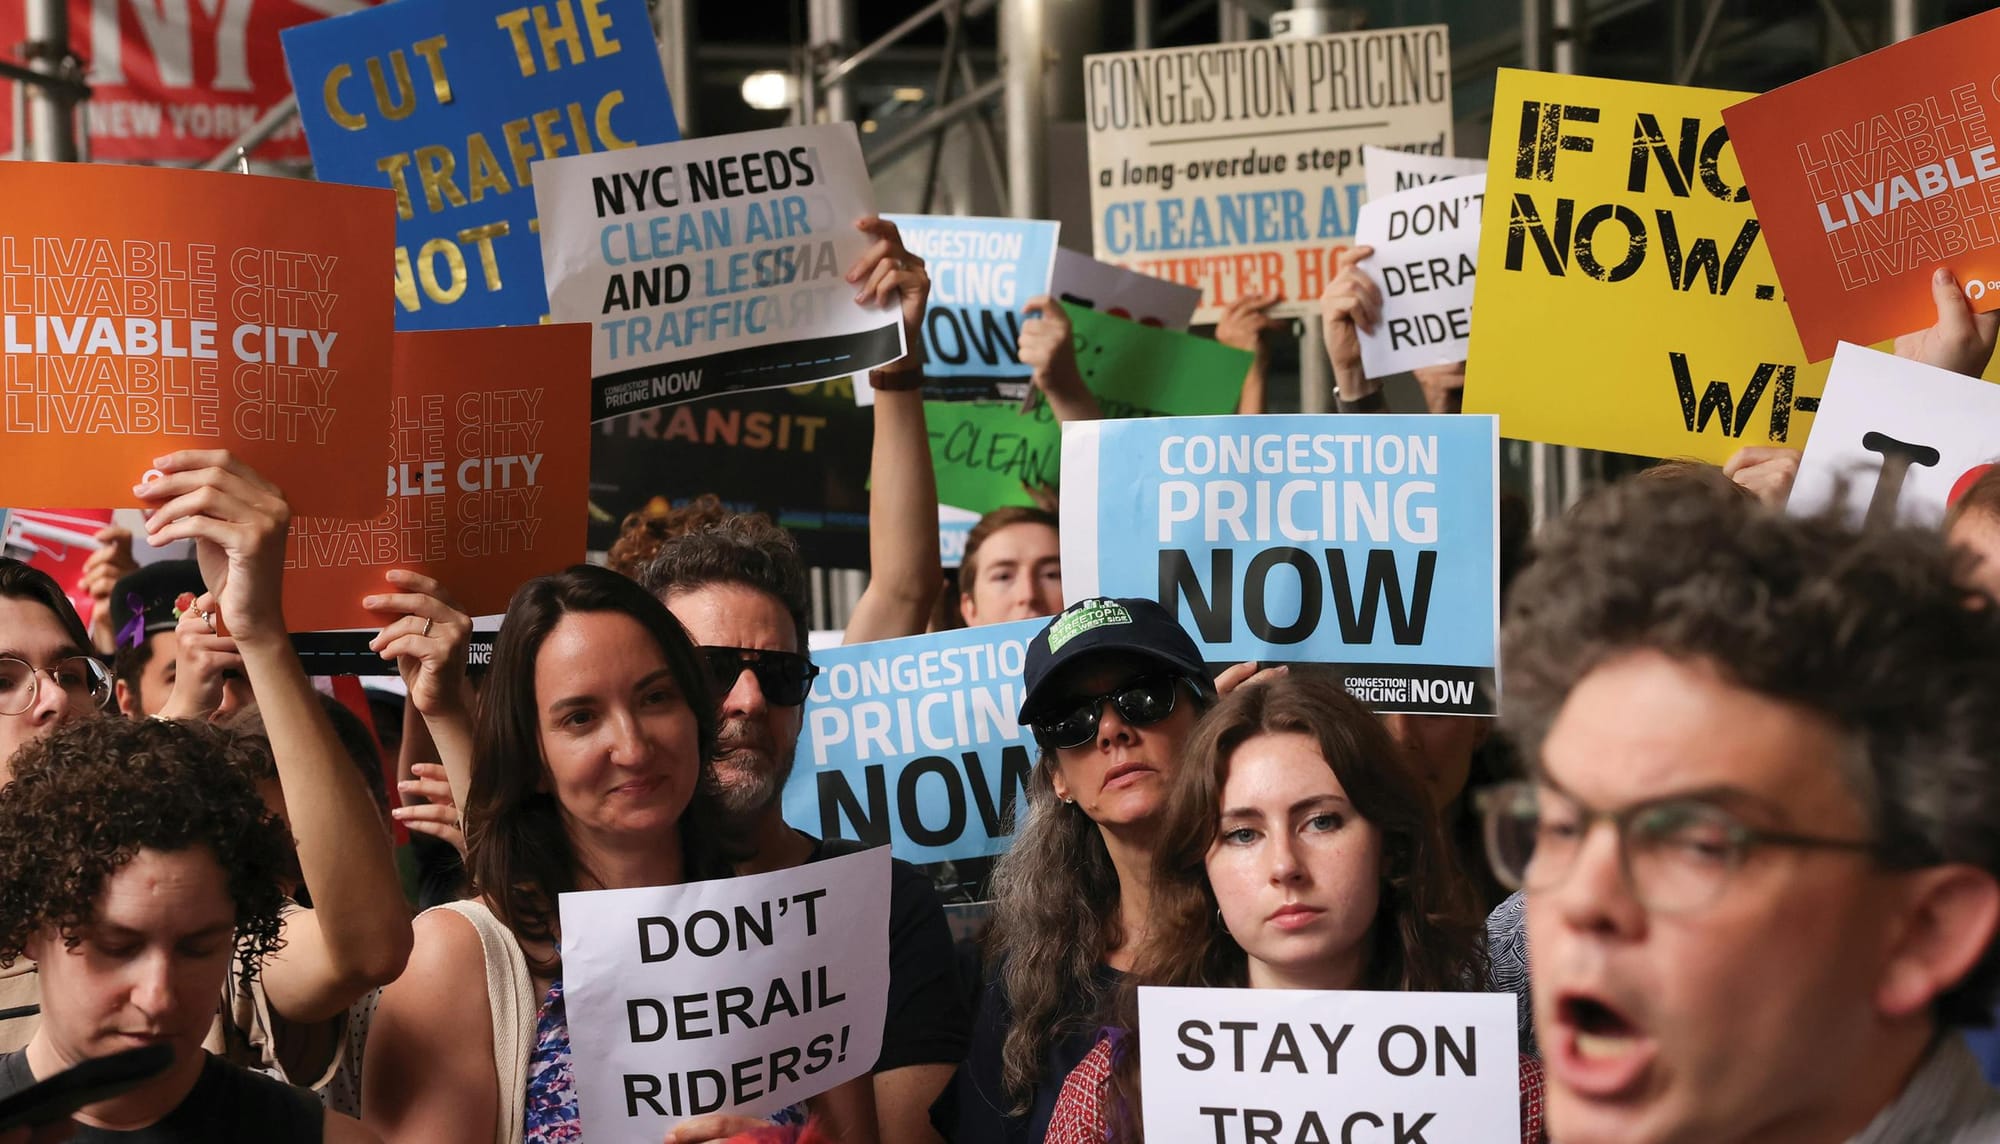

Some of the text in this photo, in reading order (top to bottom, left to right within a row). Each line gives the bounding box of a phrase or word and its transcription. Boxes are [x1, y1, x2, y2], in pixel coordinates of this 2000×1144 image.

[323, 0, 622, 132] CUT THE
[1088, 29, 1447, 132] CONGESTION PRICING
[88, 100, 163, 138] NEW
[1514, 100, 1600, 182] IF
[1796, 82, 1984, 175] LIVABLE
[376, 89, 638, 219] TRAFFIC
[591, 146, 814, 218] NYC NEEDS
[1099, 168, 1113, 188] a
[1122, 146, 1287, 191] long-overdue
[1296, 144, 1352, 177] step
[1807, 113, 1993, 204] LIVABLE
[1817, 145, 2000, 233] LIVABLE
[600, 195, 812, 267] CLEAN AIR
[1103, 188, 1310, 256] CLEANER
[2, 236, 338, 293] LIVABLE CITY
[601, 245, 797, 314] AND LESS
[3, 276, 338, 330] LIVABLE CITY
[600, 295, 768, 361] TRAFFIC
[4, 314, 338, 369] LIVABLE CITY
[5, 354, 338, 407] LIVABLE CITY
[455, 388, 544, 427] CITY
[603, 378, 649, 397] CONGESTION
[605, 387, 649, 409] PRICING
[652, 369, 703, 398] NOW
[6, 394, 338, 445] LIVABLE CITY
[456, 420, 544, 459] CITY
[456, 453, 544, 492] CITY
[1159, 434, 1438, 475] CONGESTION
[457, 485, 544, 526] CITY
[1158, 480, 1438, 543] PRICING
[456, 518, 543, 558] CITY
[1158, 546, 1438, 645] NOW
[808, 637, 1031, 703] CONGESTIO
[1344, 677, 1406, 688] CONGESTION
[1410, 679, 1475, 705] NOW
[809, 683, 1033, 765] PRICIN
[637, 888, 827, 964] DON'T
[626, 965, 846, 1043] DERAIL
[623, 1024, 851, 1117] RIDERS!
[1176, 1019, 1477, 1077] STAY ON
[1199, 1106, 1438, 1144] TRACK
